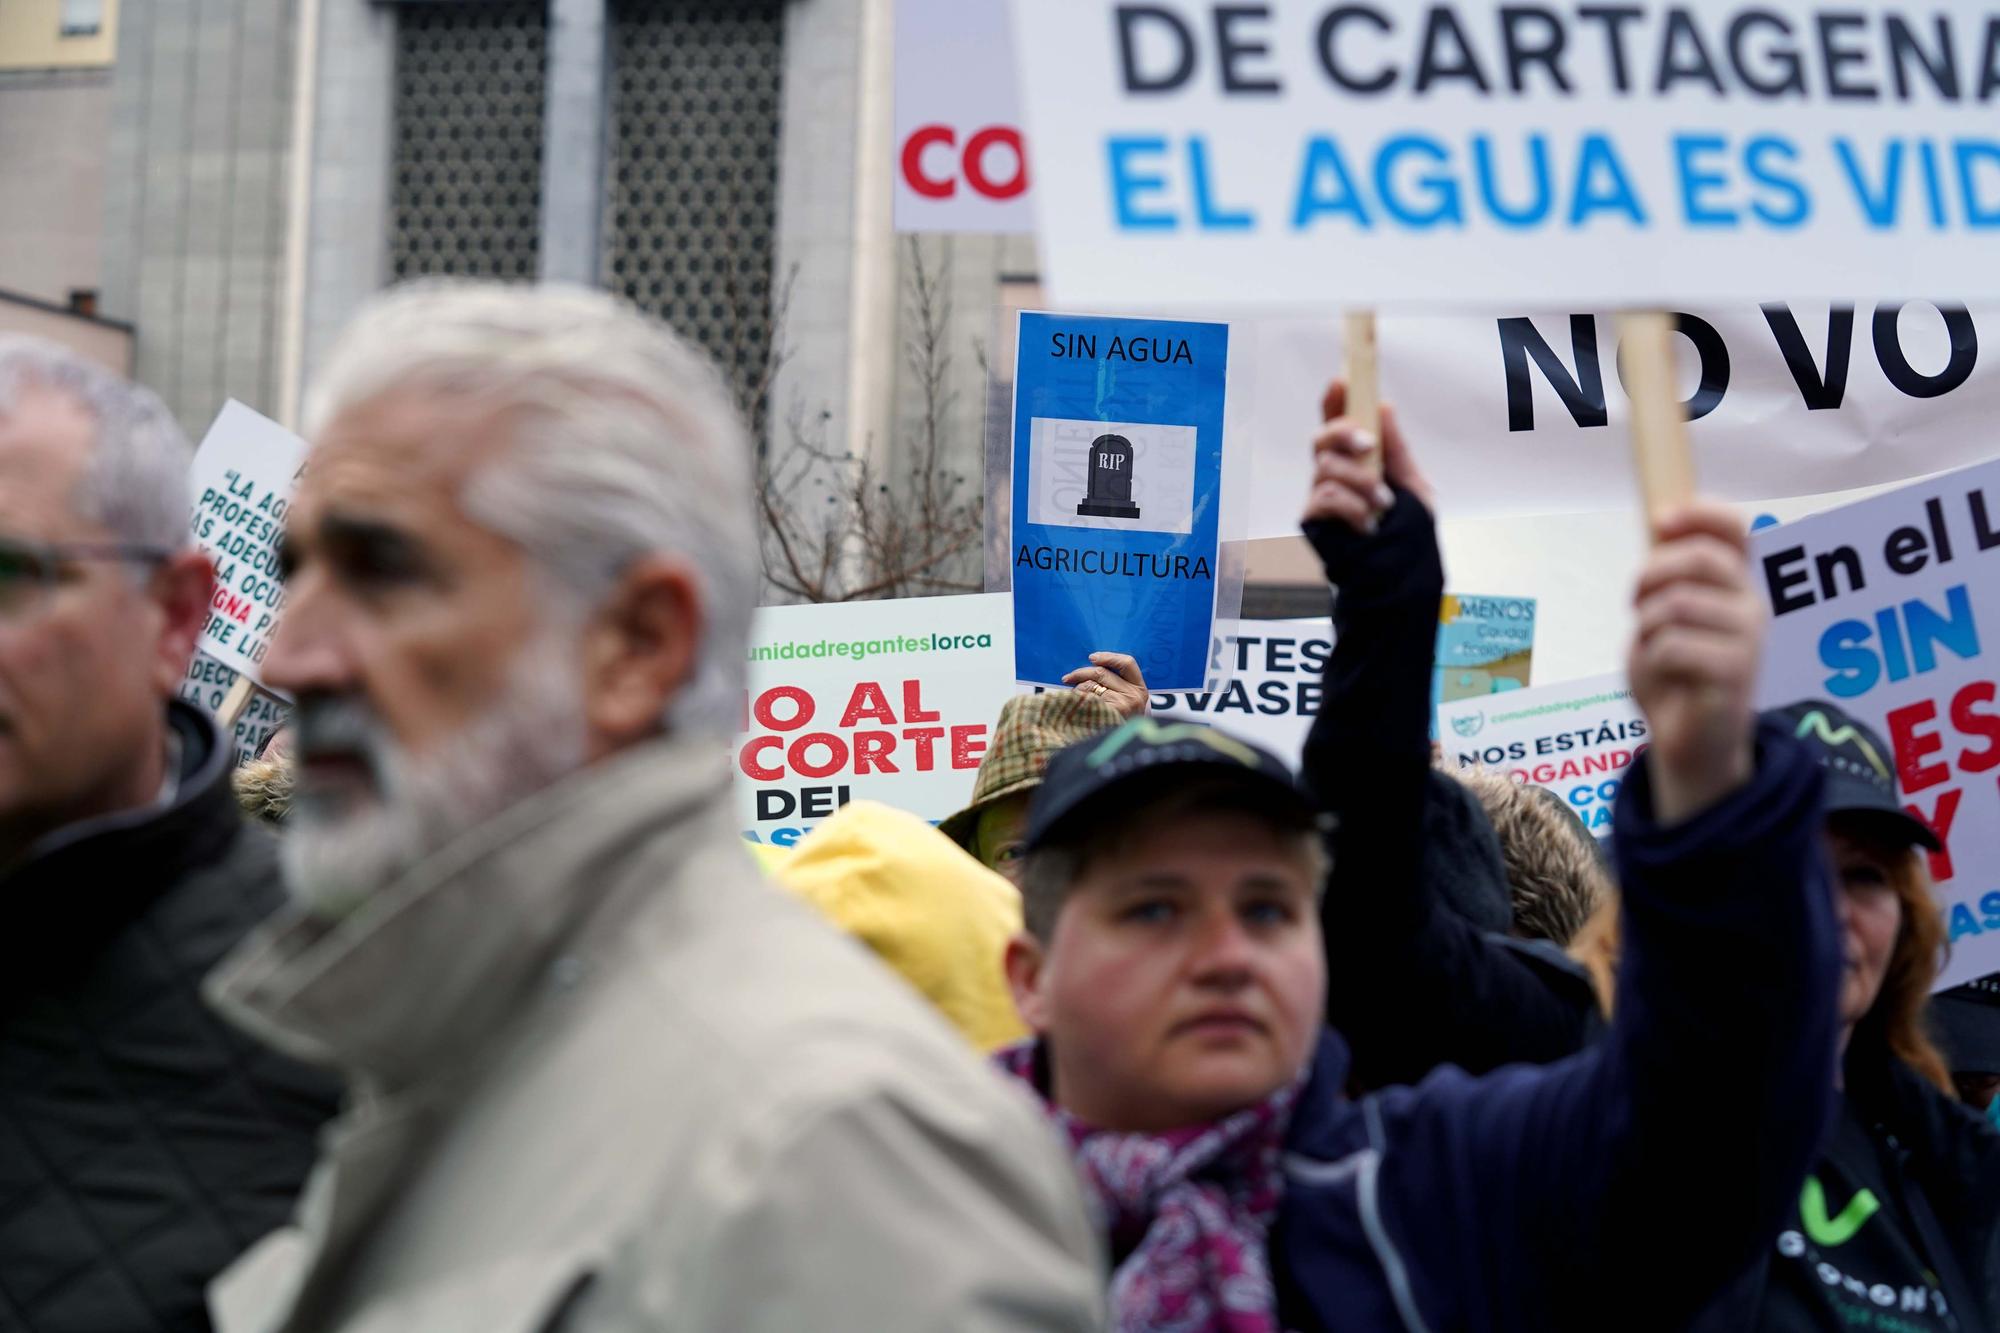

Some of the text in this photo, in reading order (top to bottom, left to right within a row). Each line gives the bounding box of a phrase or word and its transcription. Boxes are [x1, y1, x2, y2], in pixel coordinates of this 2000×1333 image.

[1114, 3, 1285, 96] DE
[900, 122, 1028, 200] CO
[1104, 134, 2000, 231] EL AGUA ES VID
[1051, 332, 1193, 365] SIN AGUA
[1497, 298, 1978, 432] NO VO
[1098, 452, 1126, 471] RIP
[1016, 544, 1211, 580] AGRICULTURA
[1762, 544, 1866, 617] En
[1884, 496, 1953, 576] el
[1461, 600, 1535, 621] MENOS
[1818, 582, 1982, 699] SIN
[744, 679, 941, 732] O AL
[739, 724, 987, 781] CORTE
[1458, 719, 1647, 769] NOS ESTÁIS
[1904, 787, 1963, 883] Y
